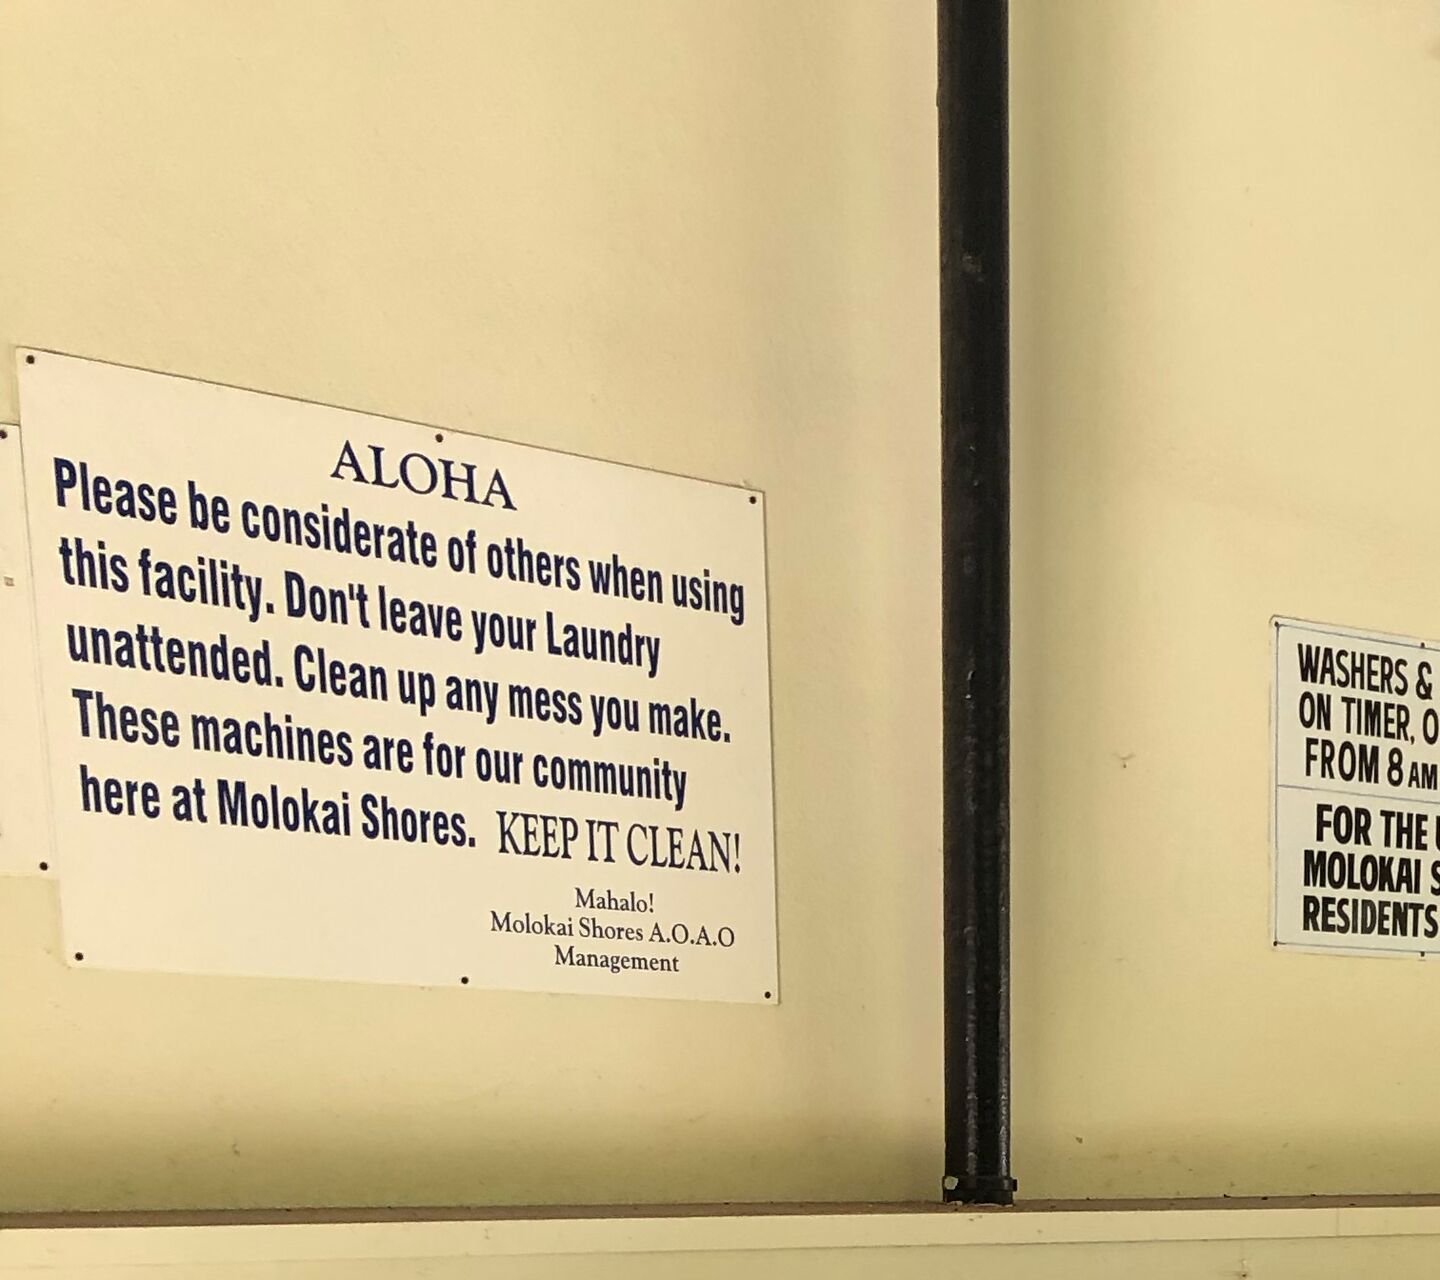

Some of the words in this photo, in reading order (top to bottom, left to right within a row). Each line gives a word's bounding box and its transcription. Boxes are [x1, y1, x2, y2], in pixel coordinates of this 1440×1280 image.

[330, 440, 517, 511] ALOHA
[53, 457, 177, 525] Please
[188, 480, 230, 534] be
[241, 501, 437, 568] considerate
[448, 529, 477, 574] of
[487, 537, 581, 591] others
[588, 553, 663, 604] when
[672, 569, 744, 626] using
[58, 537, 129, 593] this
[138, 548, 274, 623] facility.
[284, 570, 370, 628] Don't
[378, 585, 462, 642] leave
[471, 610, 536, 655] your
[546, 611, 660, 678] Laundry
[67, 624, 284, 687] unattended.
[294, 644, 388, 701] Clean
[398, 669, 435, 717] up
[446, 676, 498, 725] any
[509, 684, 582, 725] mess
[590, 695, 639, 737] you
[649, 697, 730, 743] make.
[1297, 643, 1408, 696] WASHERS
[1416, 661, 1432, 700] &
[1299, 691, 1331, 731] ON
[1341, 696, 1415, 745] TIMER,
[71, 688, 180, 747] These
[191, 712, 353, 767] machines
[363, 735, 413, 773] are
[423, 732, 466, 778] for
[476, 748, 523, 785] our
[533, 754, 687, 811] community
[1306, 737, 1379, 784] FROM
[1387, 747, 1403, 787] 8
[1408, 762, 1437, 790] AM
[79, 764, 160, 819] here
[172, 778, 208, 823] at
[217, 779, 350, 836] Molokai
[361, 793, 476, 847] Shores.
[496, 811, 578, 859] KEEP
[585, 819, 619, 863] IT
[627, 824, 740, 873] CLEAN!
[1316, 804, 1371, 846] FOR
[1380, 810, 1428, 851] THE
[1304, 849, 1421, 894] MOLOKAI
[575, 887, 653, 913] Mahalo!
[1303, 895, 1438, 938] RESIDENTS
[490, 911, 574, 936] Molokai
[579, 917, 643, 941] Shores
[649, 922, 734, 947] A.O.A.O
[554, 944, 679, 973] Management
